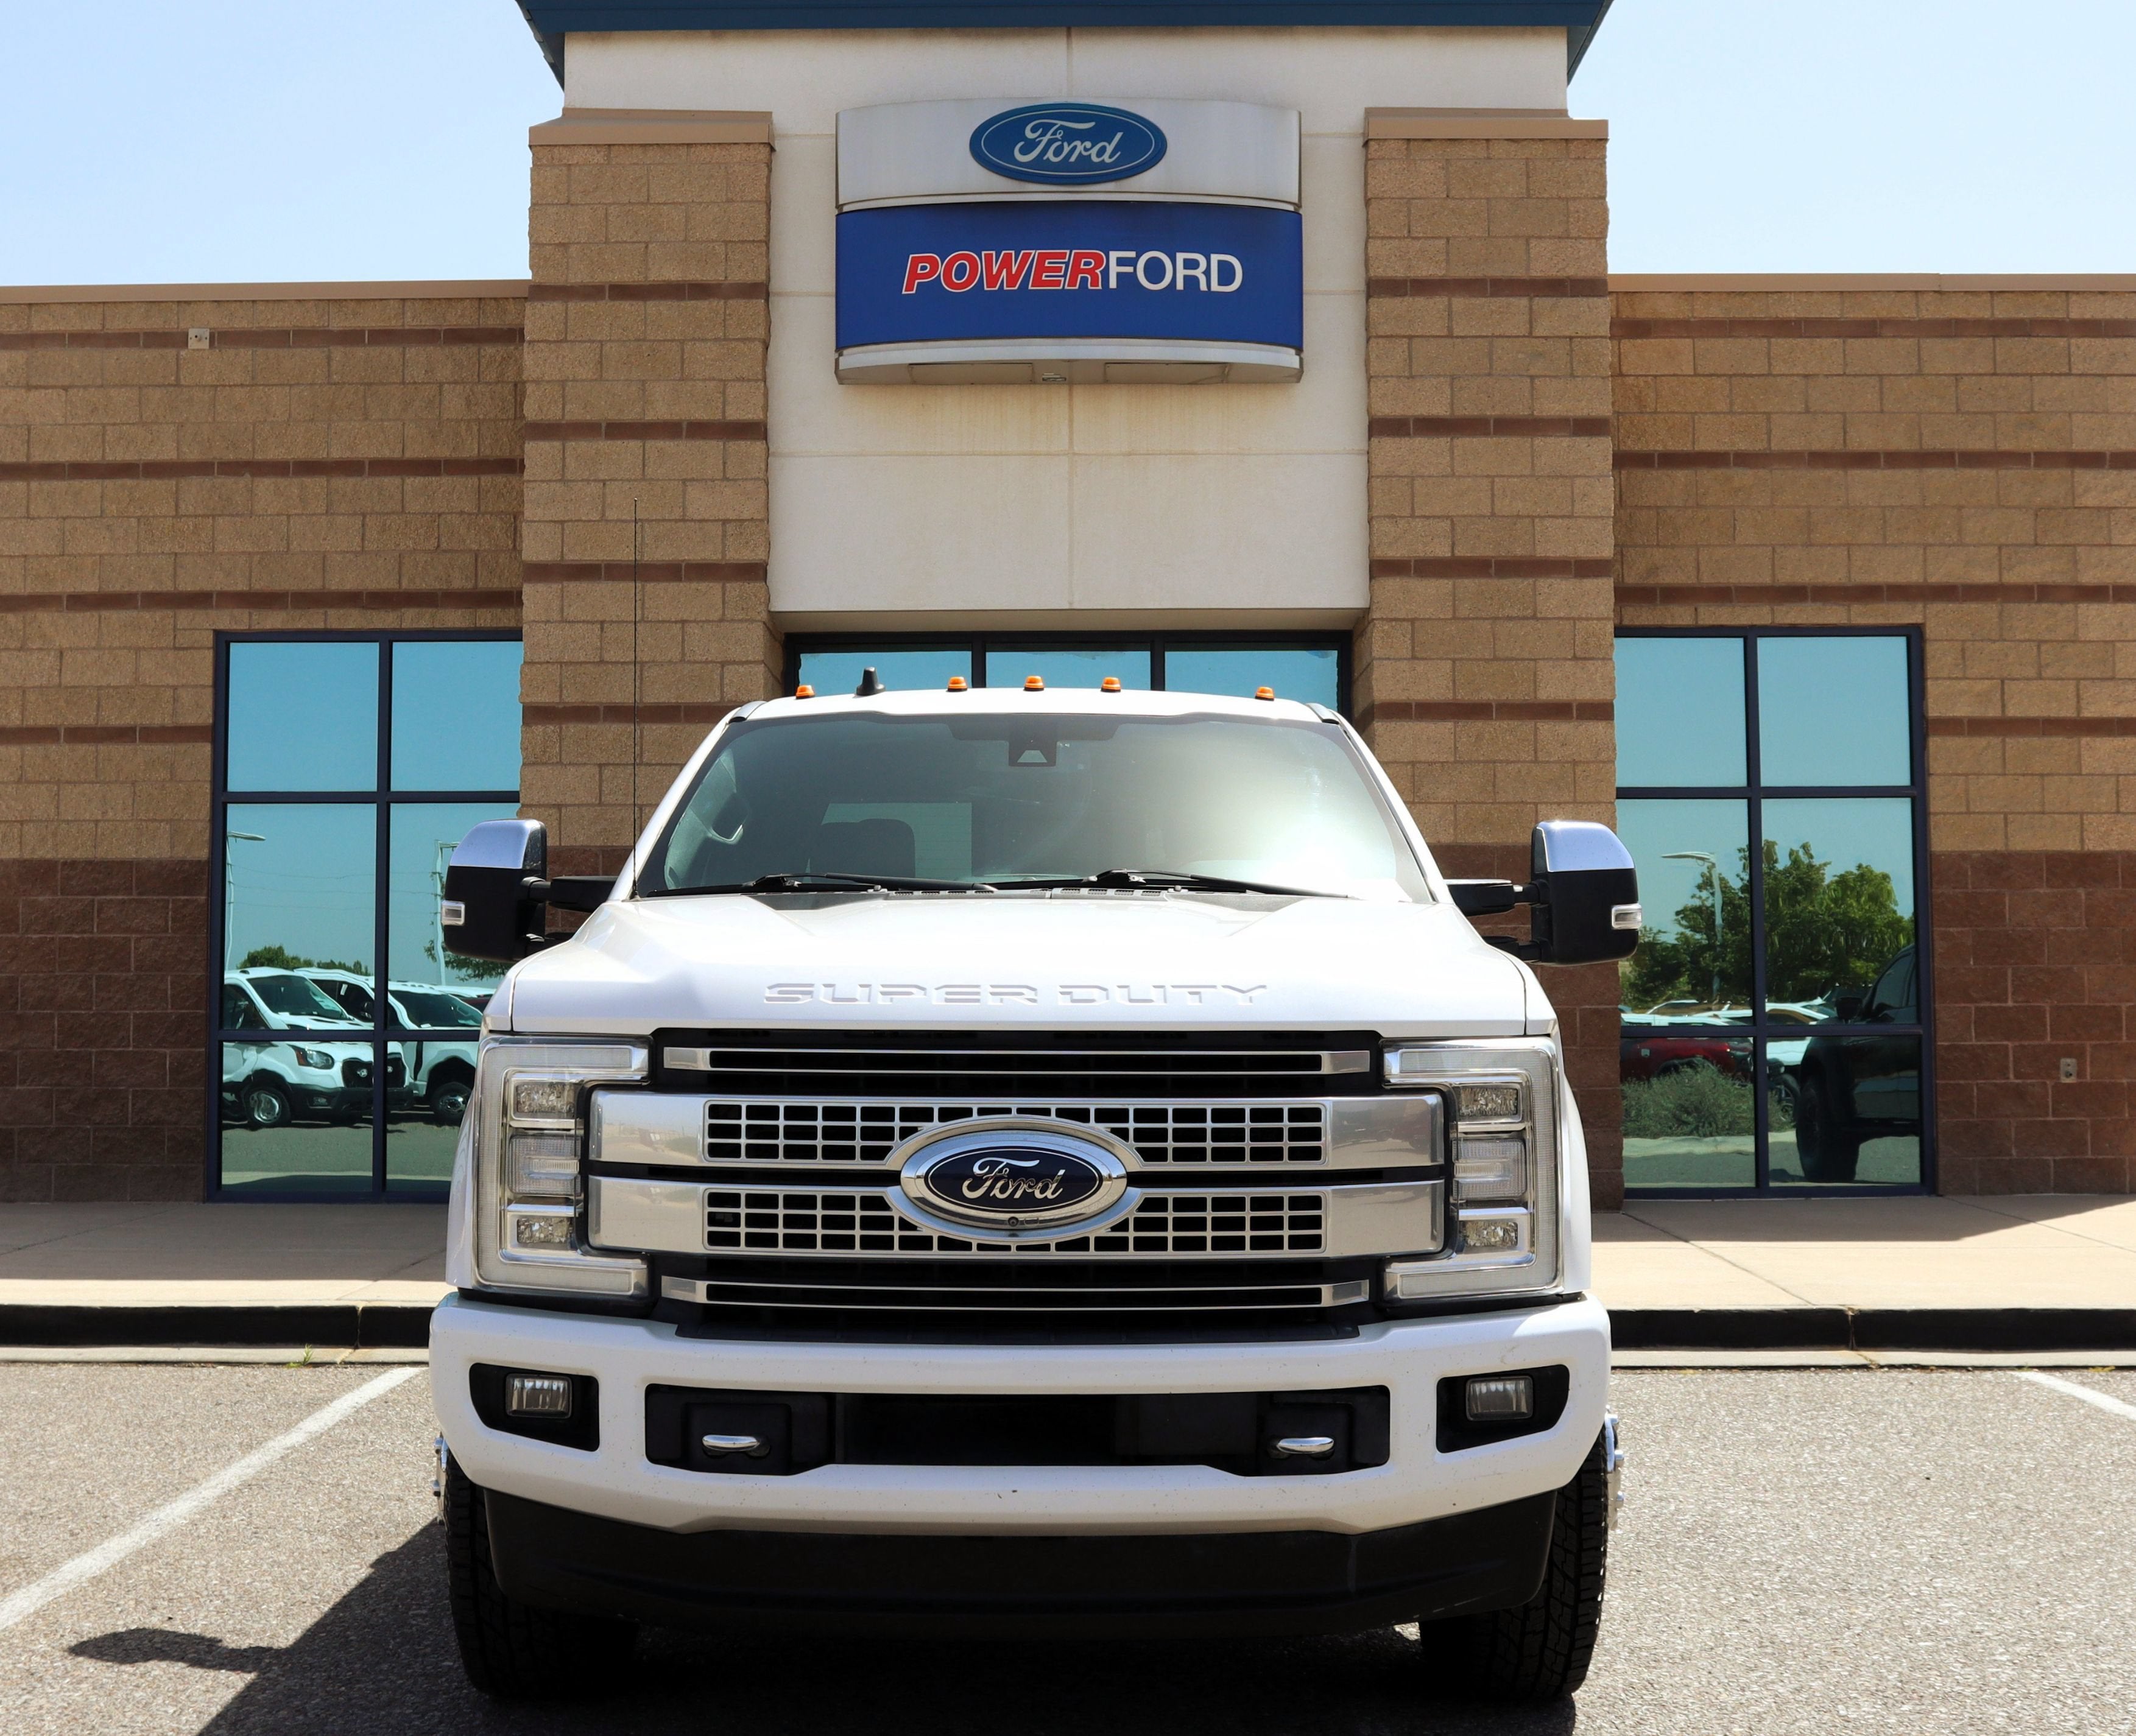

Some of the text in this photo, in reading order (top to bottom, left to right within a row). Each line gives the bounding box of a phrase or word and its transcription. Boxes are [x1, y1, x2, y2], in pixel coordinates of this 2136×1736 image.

[1013, 119, 1123, 163] Ford
[764, 983, 1267, 1006] SUPER DUTY
[962, 1157, 1066, 1200] Ford
